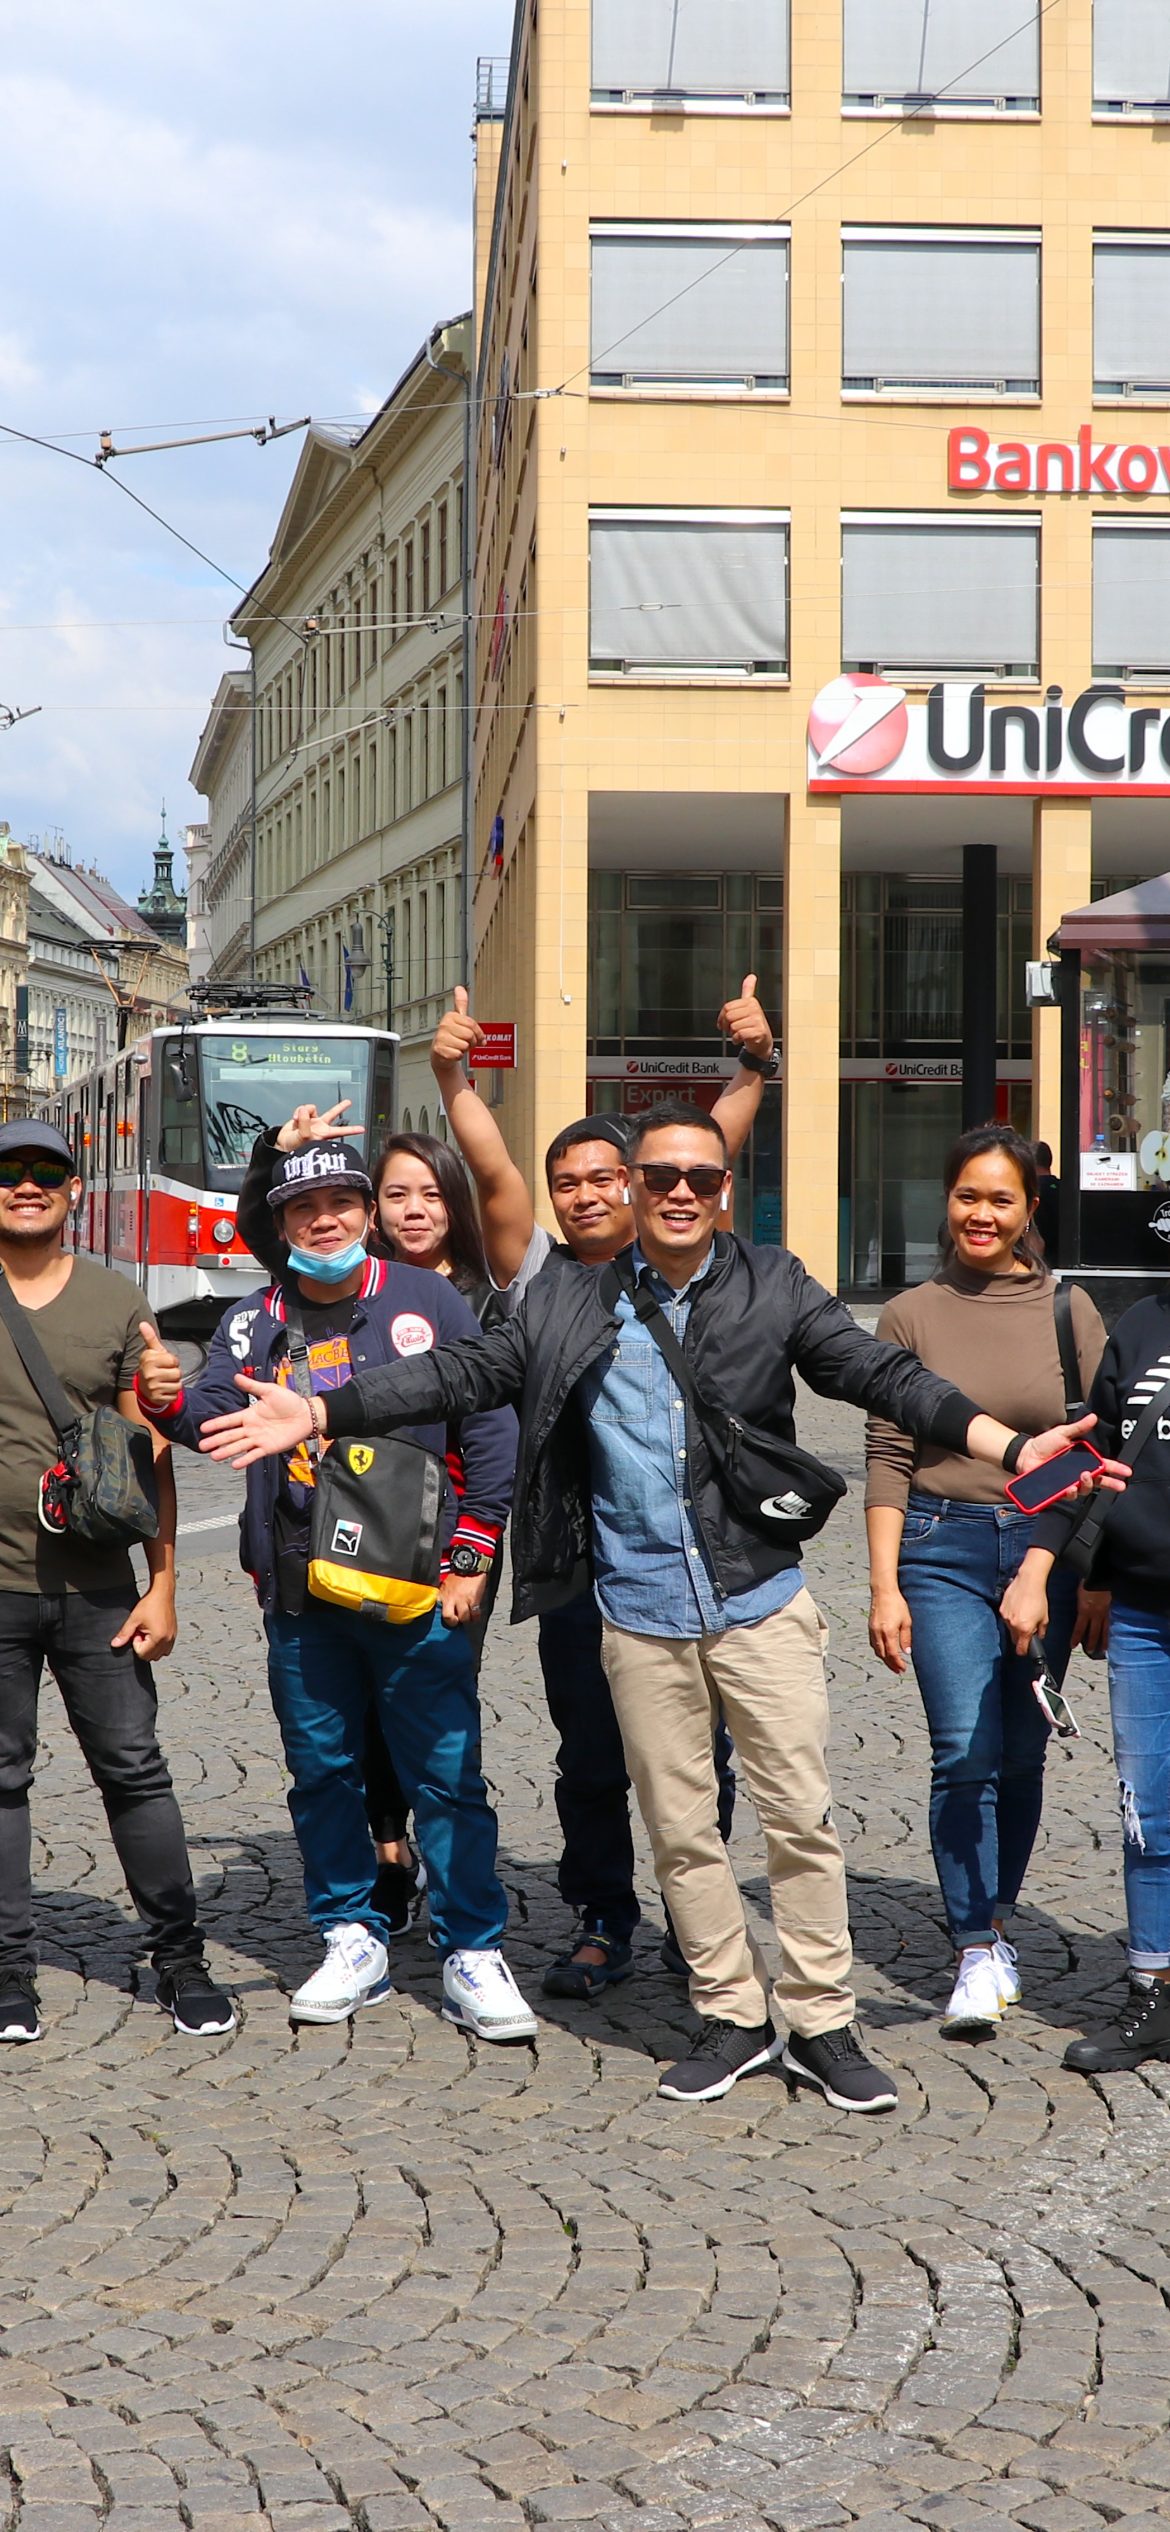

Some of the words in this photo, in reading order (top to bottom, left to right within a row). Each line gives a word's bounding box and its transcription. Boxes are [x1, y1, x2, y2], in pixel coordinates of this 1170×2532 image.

[928, 683, 1170, 774] UniCr
[231, 1041, 248, 1062] 8
[640, 1062, 690, 1074] UniCredit
[692, 1062, 720, 1074] Bank
[899, 1064, 948, 1076] UniCredit
[626, 1085, 696, 1104] Expert
